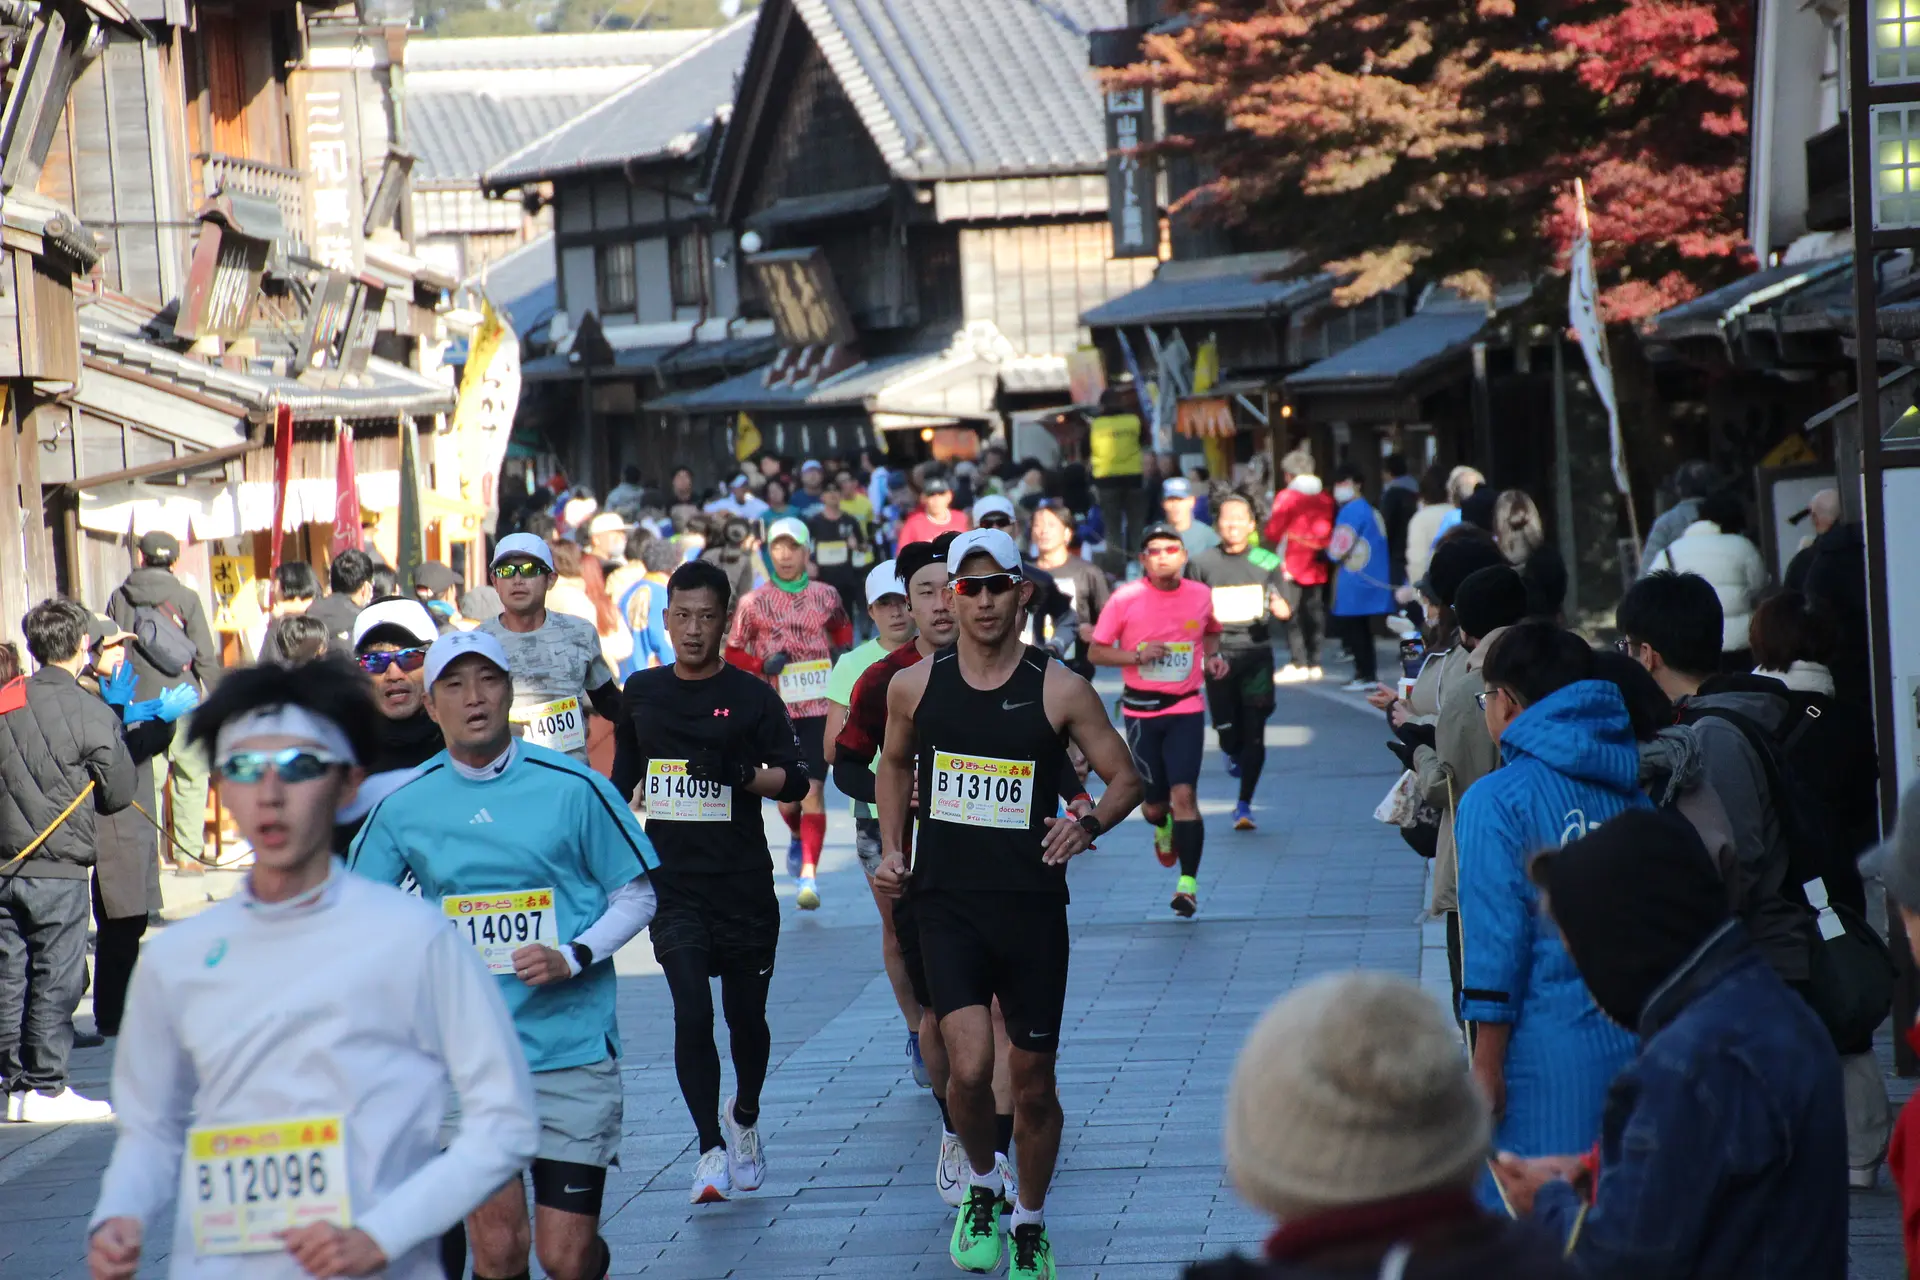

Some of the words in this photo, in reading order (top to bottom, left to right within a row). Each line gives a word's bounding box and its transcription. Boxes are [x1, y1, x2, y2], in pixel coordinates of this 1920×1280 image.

[938, 771, 1022, 804] B13106
[999, 806, 1025, 814] docomo
[198, 1150, 327, 1206] B12096
